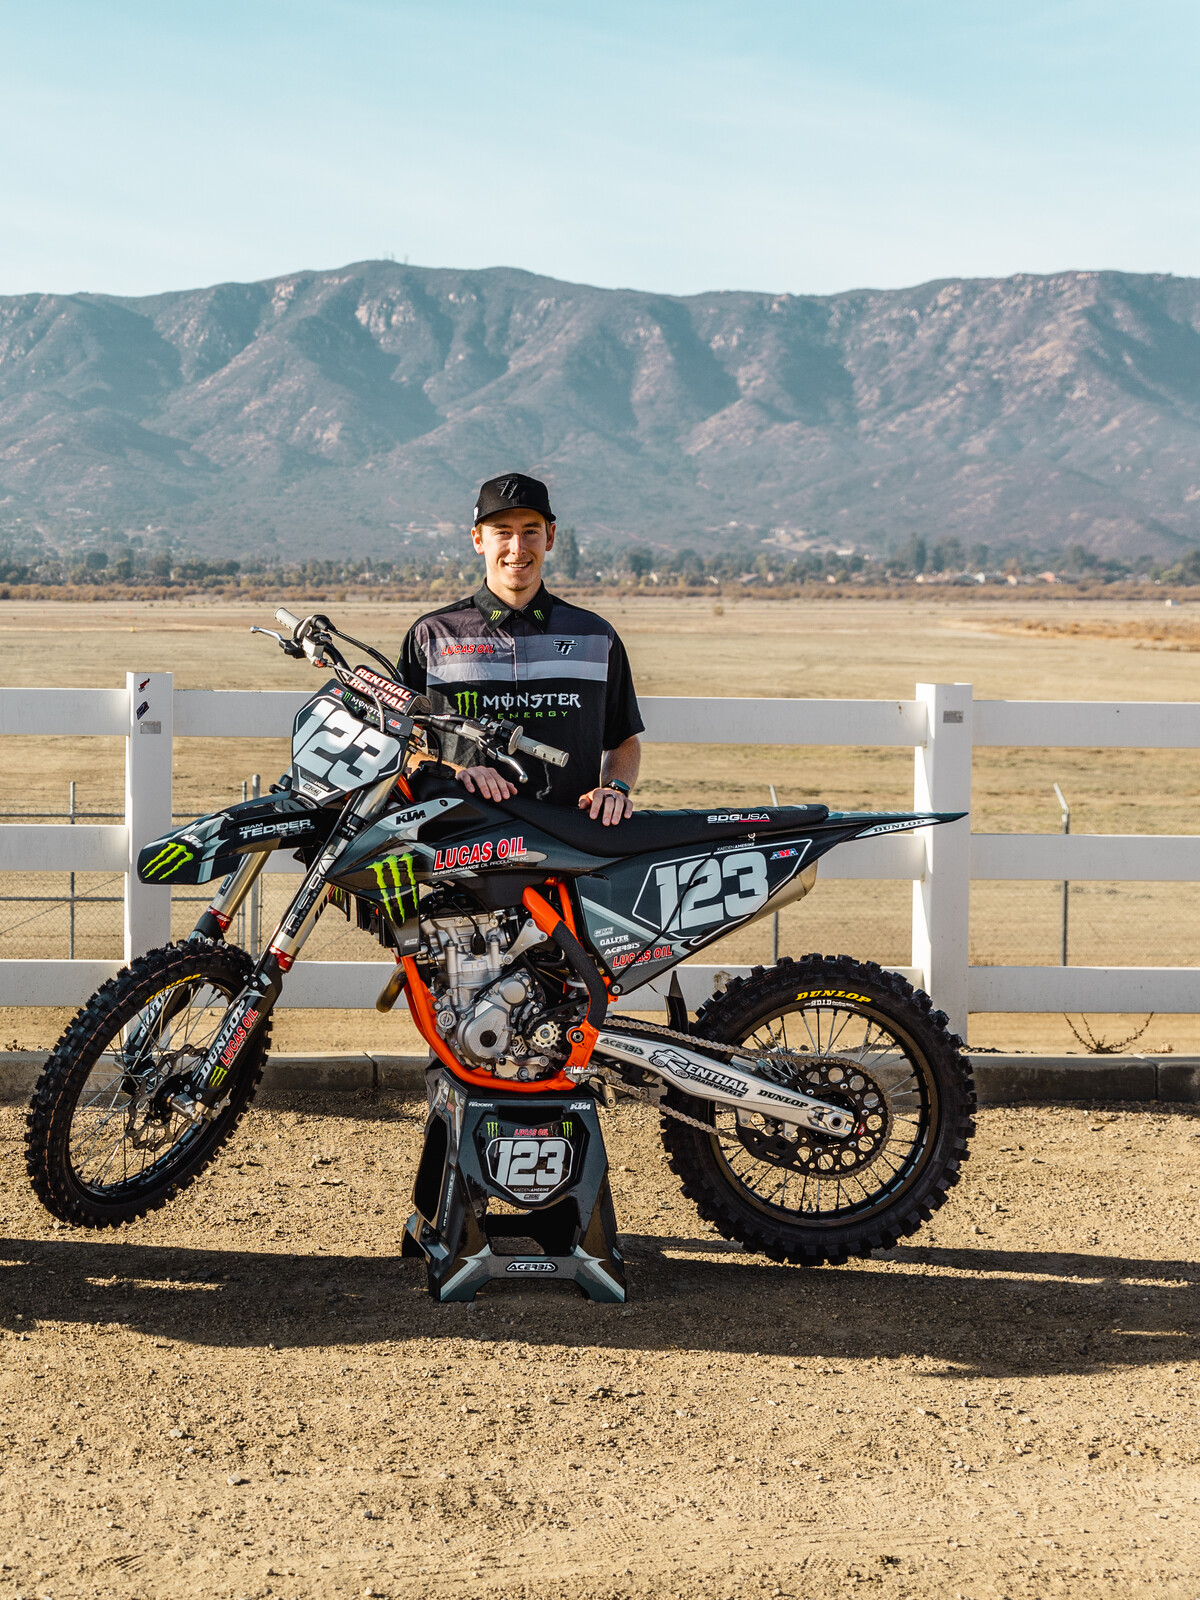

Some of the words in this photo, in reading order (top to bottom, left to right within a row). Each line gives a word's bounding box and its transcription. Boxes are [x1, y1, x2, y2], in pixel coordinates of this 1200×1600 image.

[441, 644, 475, 655] LUCAS
[477, 644, 494, 654] OIL
[355, 667, 412, 700] RENTHAL
[349, 677, 406, 711] RENTHAL
[482, 692, 581, 711] MONSTER
[498, 710, 568, 719] ENERGY
[293, 700, 400, 792] 123
[396, 809, 427, 825] KTM
[874, 820, 925, 832] DUNLOP
[239, 823, 263, 831] TEAM
[239, 819, 311, 839] TEDDER
[434, 841, 493, 870] LUCAS
[497, 836, 527, 860] OIL
[432, 864, 480, 876] HI-PERFORMANCE
[656, 851, 769, 933] 123
[600, 935, 629, 946] GALFER
[613, 949, 651, 967] LUCAS
[654, 945, 673, 959] OIL
[795, 990, 872, 1003] DUNLOP
[200, 999, 246, 1080] DUNLOP
[220, 1027, 247, 1066] LUCAS
[242, 1007, 258, 1028] OIL
[600, 1038, 644, 1055] ACERBIS
[689, 1075, 745, 1098] CHAINWHEELS
[570, 1102, 591, 1110] KTM
[757, 1089, 810, 1108] DUNLOP
[538, 1128, 549, 1136] OIL
[496, 1140, 566, 1186] 123
[508, 1262, 555, 1270] ACERBIS
